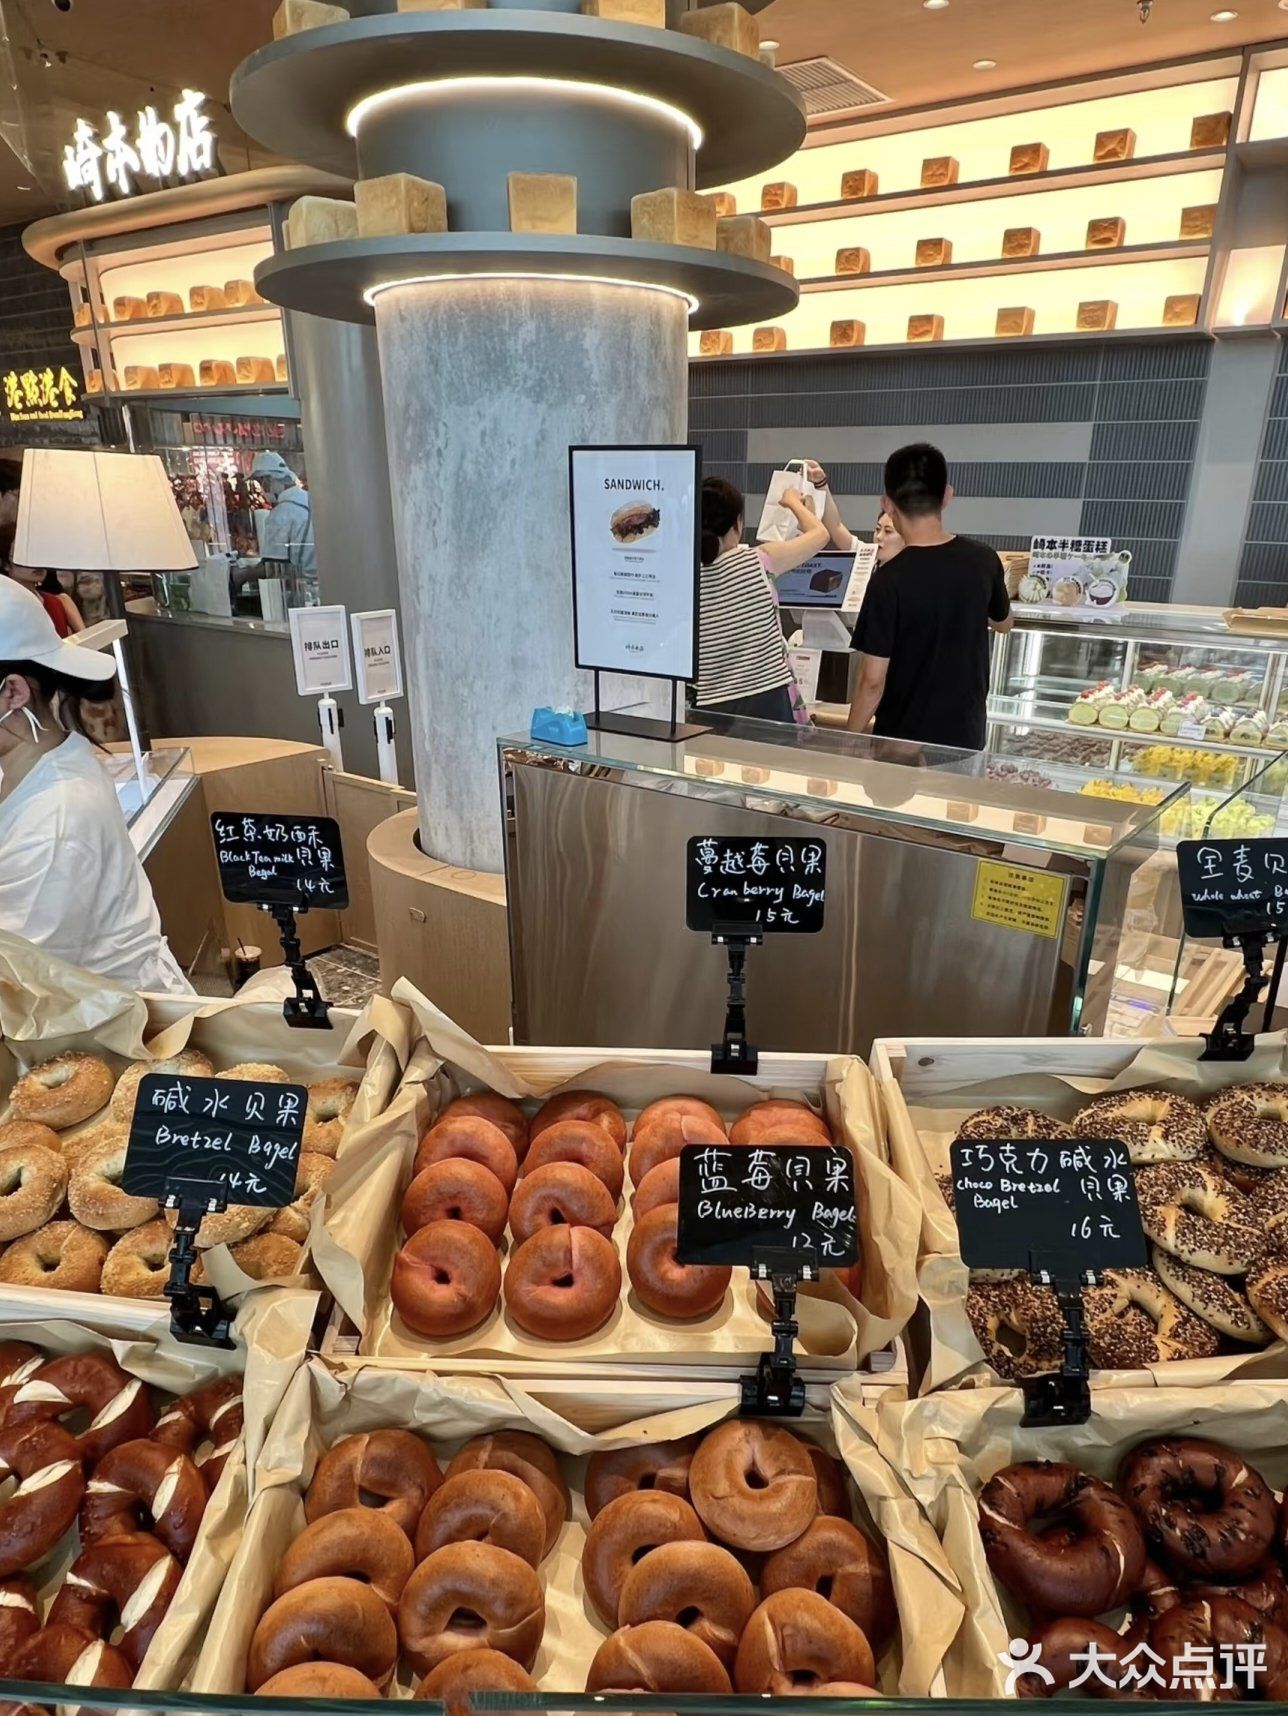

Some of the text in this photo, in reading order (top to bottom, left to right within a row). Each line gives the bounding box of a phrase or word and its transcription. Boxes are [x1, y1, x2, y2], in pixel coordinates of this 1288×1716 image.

[604, 478, 665, 491] SANDWICH.
[304, 640, 339, 652] 排队出口
[364, 646, 391, 658] 排队入口
[220, 850, 251, 863] Black
[792, 883, 825, 907] Bagel
[755, 908, 800, 924] 15元
[152, 1081, 299, 1127] 碱水贝果
[155, 1124, 233, 1151] Bretzel
[960, 1143, 1127, 1174] 巧克力碱水
[1000, 1178, 1061, 1193] Bretzel
[974, 1193, 1018, 1214] Bagel
[811, 1201, 854, 1229] Bagel
[1070, 1214, 1121, 1239] 16元
[791, 1232, 846, 1257] 12元
